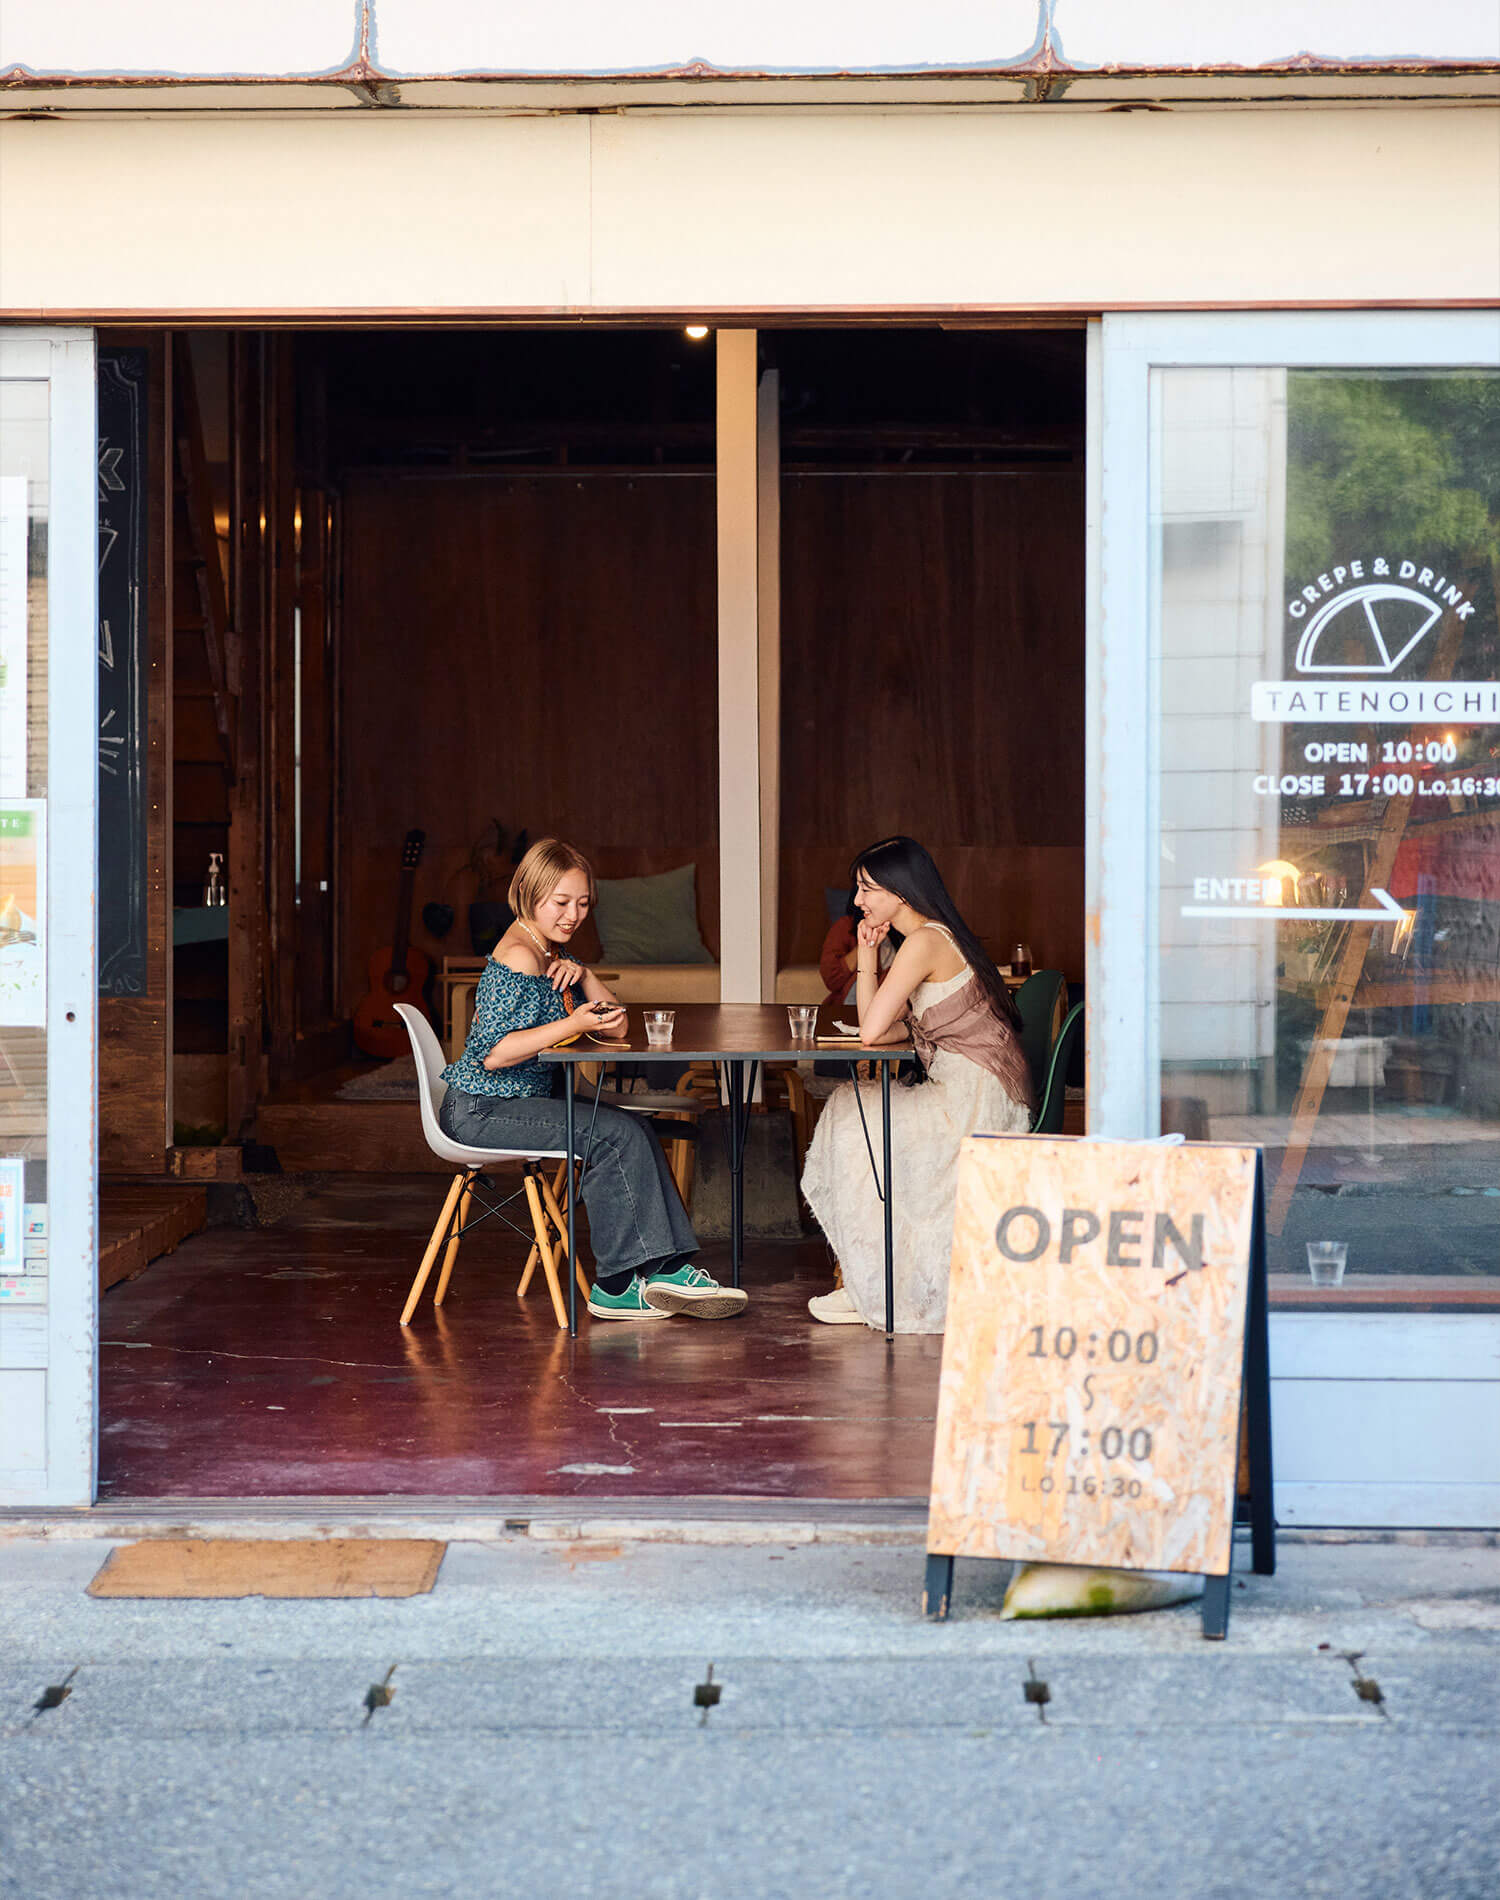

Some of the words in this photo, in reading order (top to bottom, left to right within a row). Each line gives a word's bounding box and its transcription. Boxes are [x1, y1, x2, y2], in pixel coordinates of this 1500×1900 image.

[1288, 560, 1365, 618] CREPE
[1373, 557, 1390, 576] &
[1399, 560, 1476, 621] DRINK
[1266, 691, 1497, 713] TATENOICHI
[1304, 742, 1368, 763] OPEN
[1382, 741, 1457, 764] 10:00
[1253, 774, 1326, 796] CLOSE
[1338, 773, 1415, 796] 17:00
[995, 1204, 1206, 1272] OPEN
[1026, 1324, 1160, 1365] 10:00
[1018, 1420, 1153, 1462] 17:00
